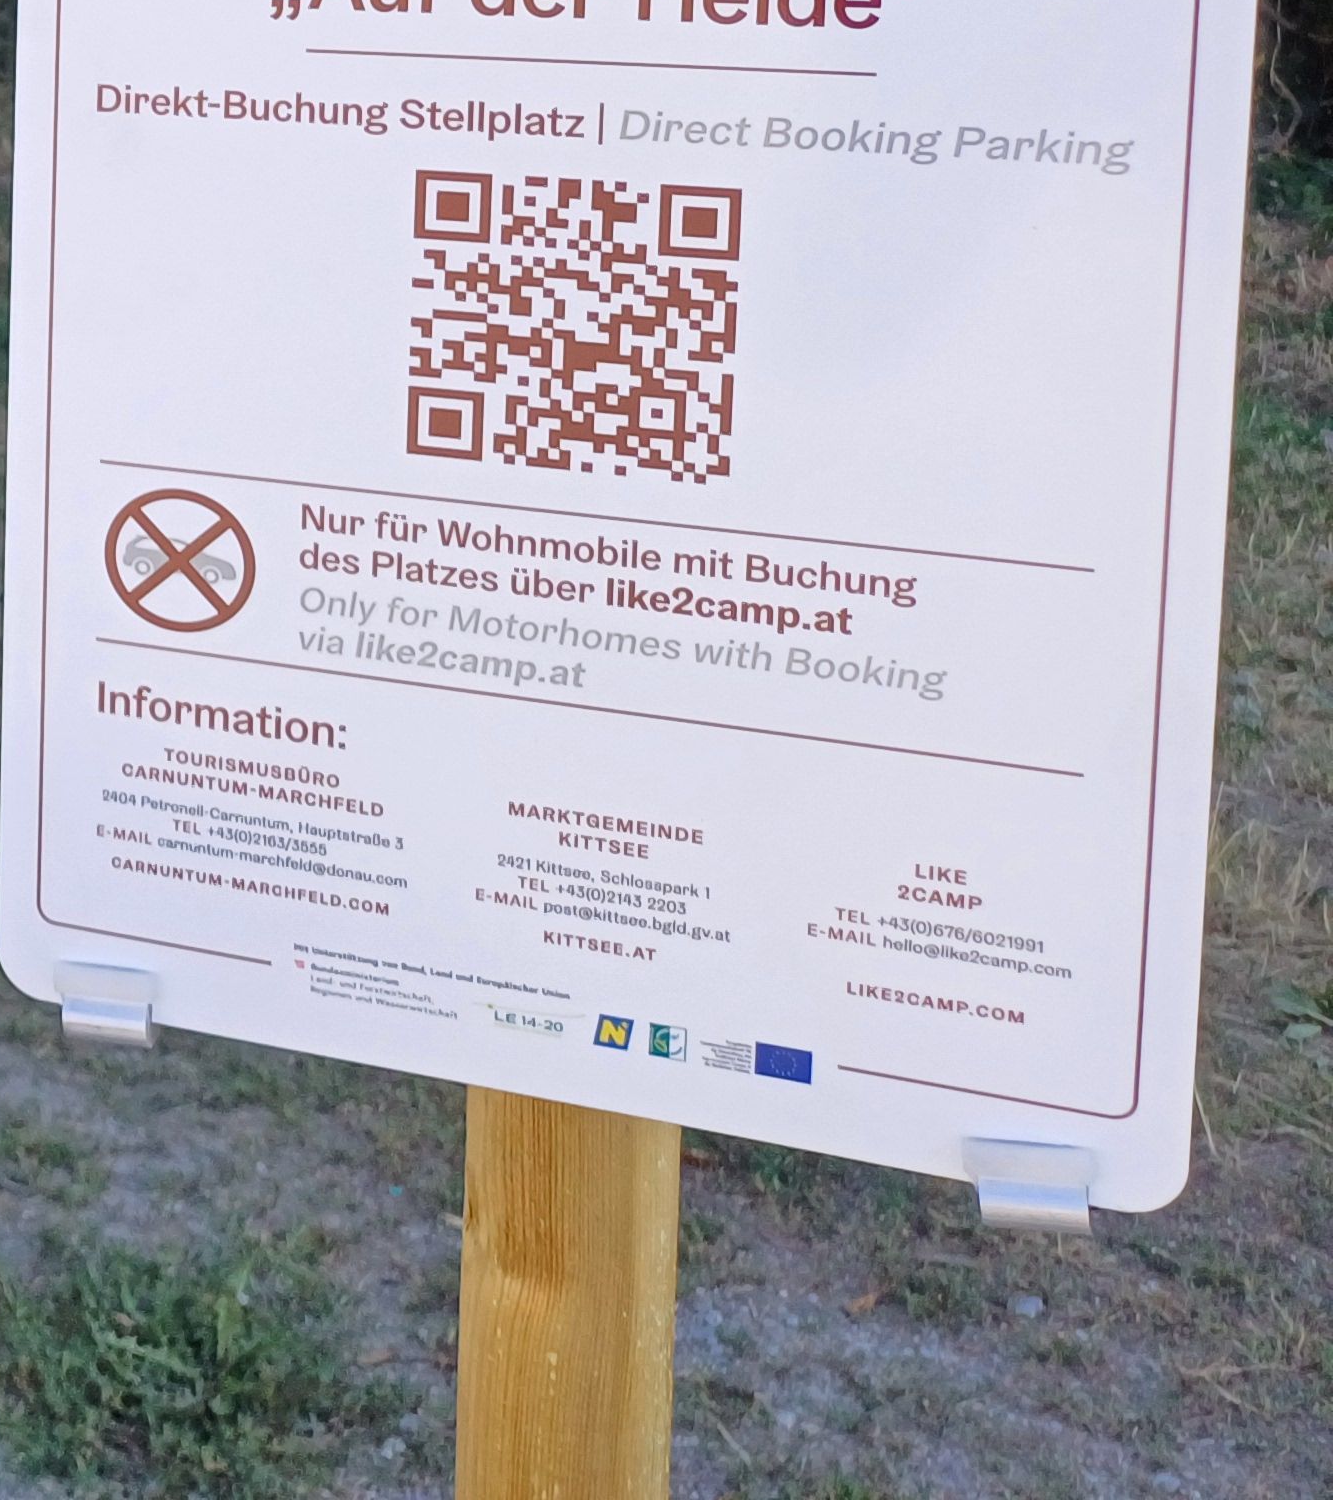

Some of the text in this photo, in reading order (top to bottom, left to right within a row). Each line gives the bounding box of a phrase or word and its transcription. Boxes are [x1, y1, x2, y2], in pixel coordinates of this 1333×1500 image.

[96, 83, 1135, 175] Direkt-Buchung Stellplatz Direct Booking Parking
[301, 503, 918, 608] Nur für Wohnmobile mit Buchung
[299, 542, 853, 636] des Platzes über like2camp.at
[299, 627, 586, 688] via like2camp.at
[300, 587, 948, 701] Only for Motorhomes with Booking
[97, 680, 347, 750] Information:
[121, 762, 384, 818] CARNUNTUM-MARCHFELD
[163, 747, 340, 788] TOURISMUSBÜRO
[102, 789, 136, 806] 2404
[173, 818, 201, 836] TEL
[508, 801, 704, 845] MARKTGEMEINDE
[558, 831, 649, 859] KITTSEE
[96, 823, 408, 889] E-MAIL carnuntum-marchfeld@donau.com
[497, 853, 531, 871] 2421
[536, 859, 595, 883] Kittsee,
[600, 870, 699, 898] Schlosspark
[915, 863, 968, 886] LIKE
[111, 856, 390, 917] CARNUNTUM-MARCHFELD.COM
[518, 875, 687, 915] TEL +43(0)2143 2203
[897, 884, 983, 910] 2CAMP
[475, 887, 731, 943] E-MAIL post@kittsee.bgld.gv.at
[835, 906, 1044, 954] TEL +43(0)676/6021991
[543, 930, 657, 961] KITTSEE.AT
[807, 922, 1072, 979] E-MAIL hello@like2camp.com
[846, 981, 1025, 1024] LIKE2CAMP.COM
